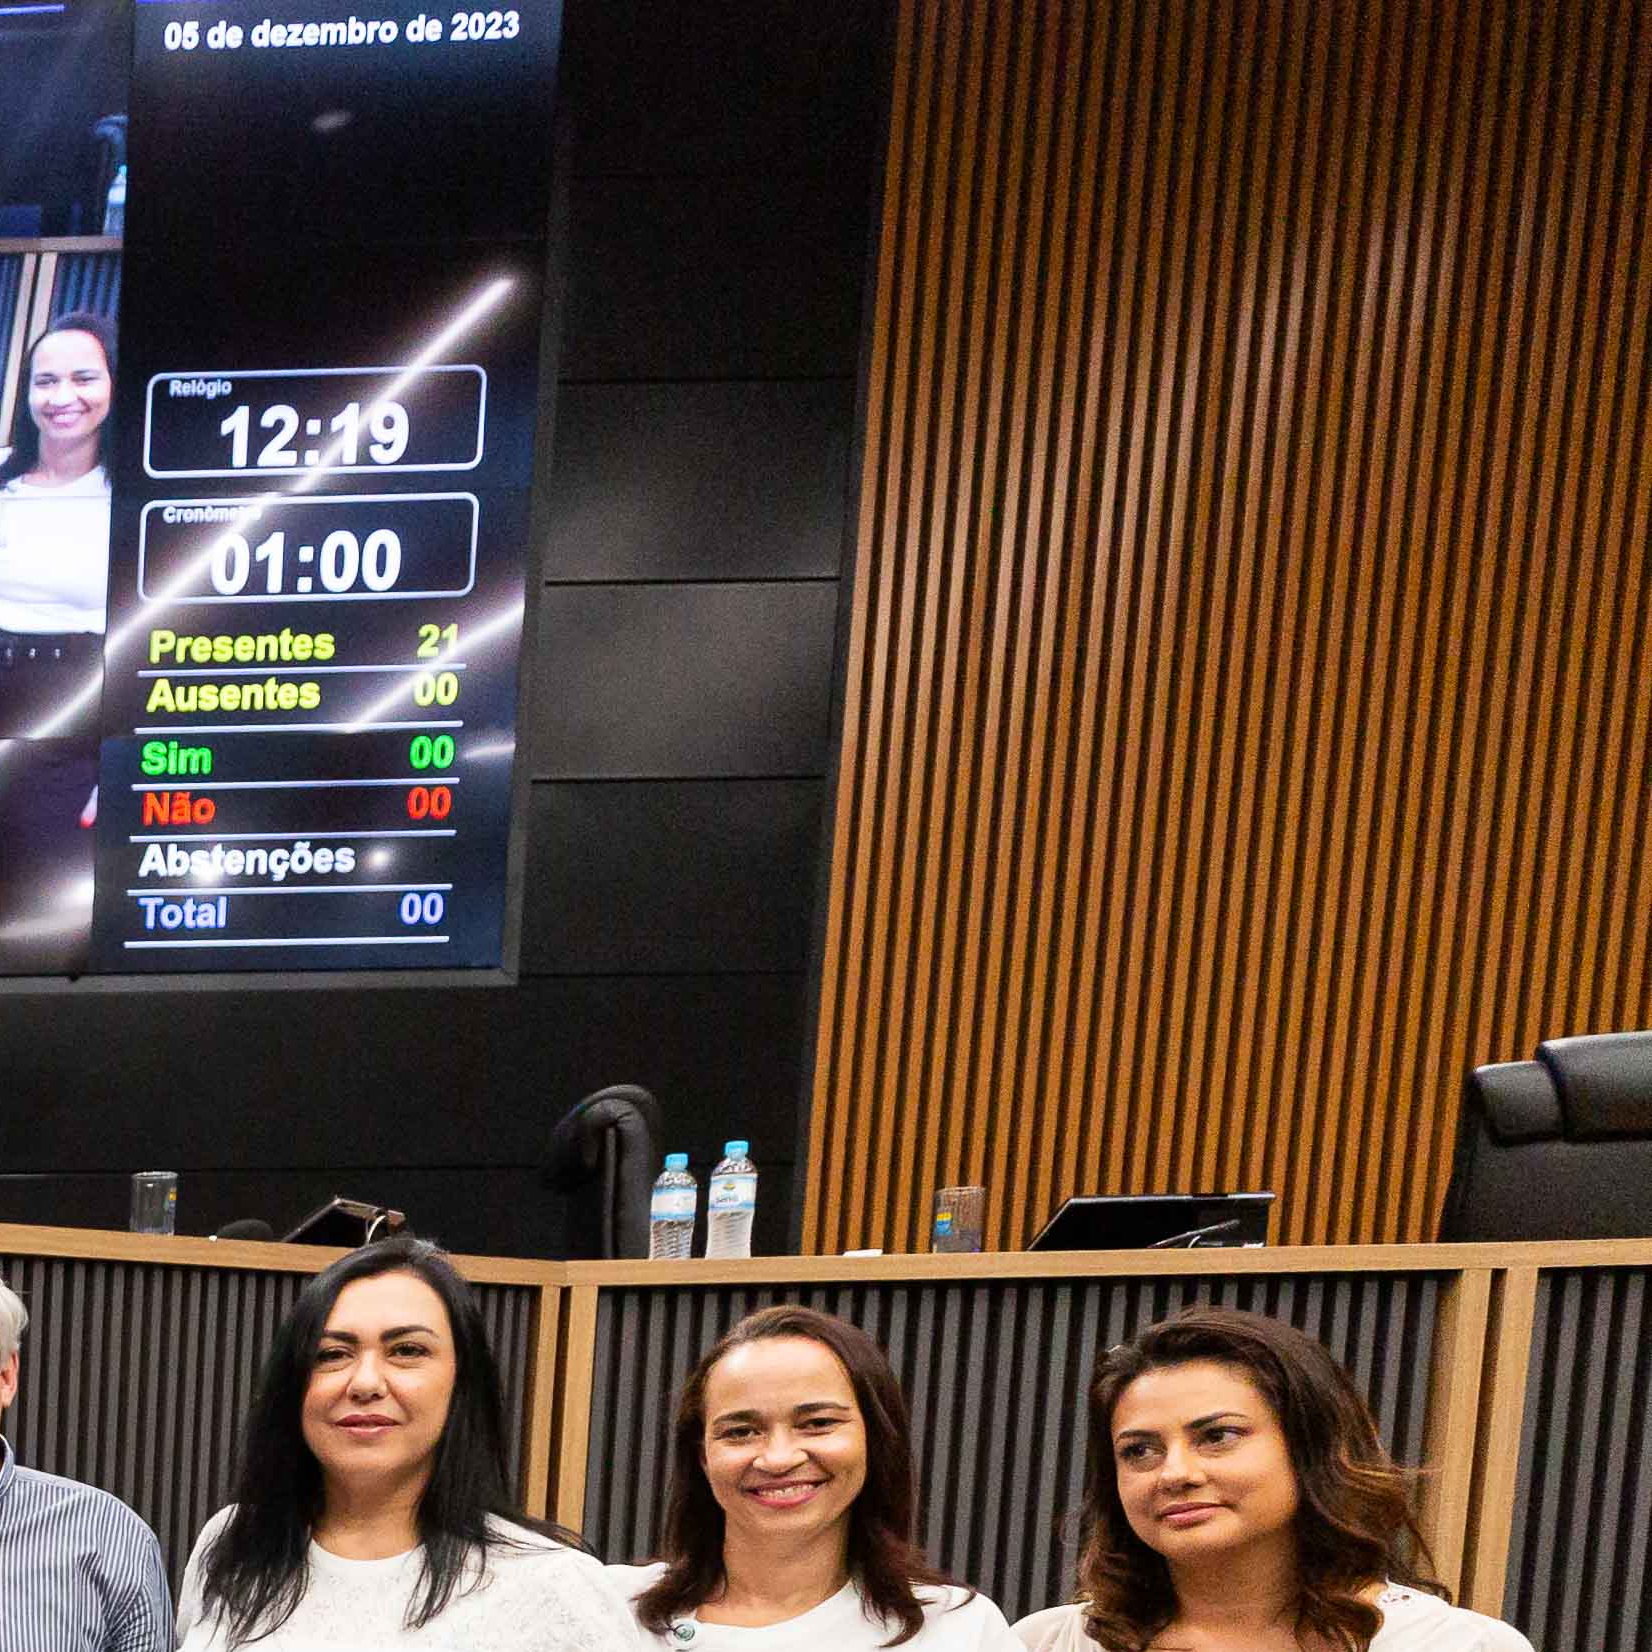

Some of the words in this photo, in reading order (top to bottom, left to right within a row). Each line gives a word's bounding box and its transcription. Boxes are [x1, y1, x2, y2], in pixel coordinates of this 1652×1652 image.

[164, 22, 199, 51] 05
[206, 21, 243, 49] de
[251, 15, 398, 48] dezembro
[405, 14, 443, 43] de
[450, 11, 521, 41] 2023
[169, 380, 232, 399] Relógio
[220, 403, 410, 468] 12:19
[163, 505, 261, 523] Cronôm
[210, 529, 402, 596] 01:00
[148, 628, 336, 664] Presentes
[417, 624, 460, 658] 21
[146, 677, 321, 713] Ausentes
[412, 672, 459, 707] 00
[141, 740, 213, 775] Sim
[409, 735, 455, 769] 00
[143, 792, 216, 826] Não
[407, 786, 452, 820] 00
[138, 841, 356, 881] Abstenções
[137, 896, 228, 930] Total
[400, 893, 445, 926] 00
